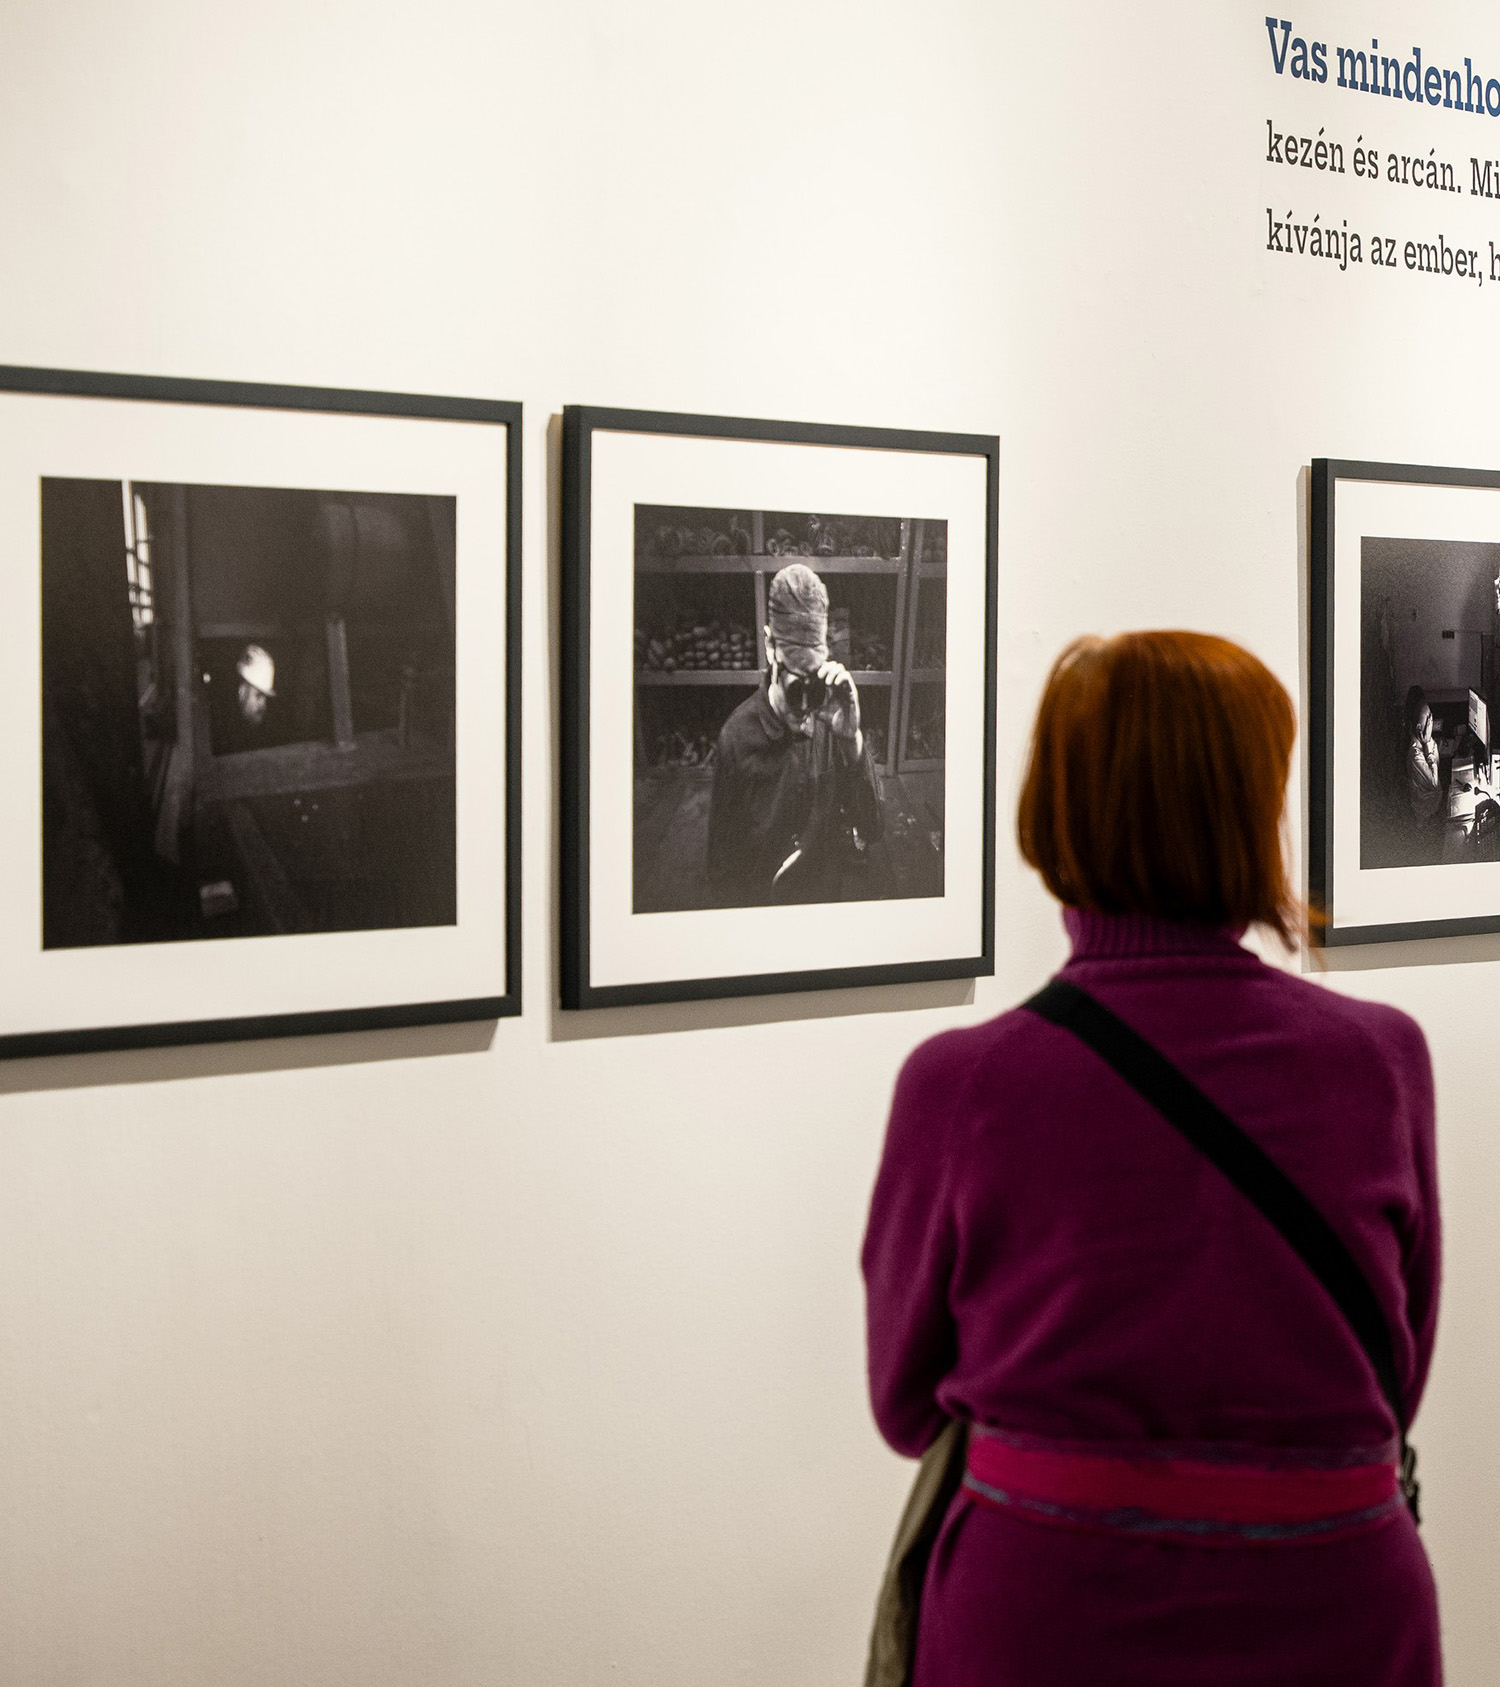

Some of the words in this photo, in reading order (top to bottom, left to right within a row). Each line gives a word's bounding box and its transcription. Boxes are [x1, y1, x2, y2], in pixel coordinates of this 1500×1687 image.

[1265, 16, 1328, 84] Vas
[1266, 118, 1346, 174] kezén
[1352, 134, 1379, 180] és
[1386, 147, 1462, 194] arcán.
[1266, 207, 1363, 272] kívánja
[1370, 236, 1397, 268] az
[1403, 234, 1483, 288] ember,
